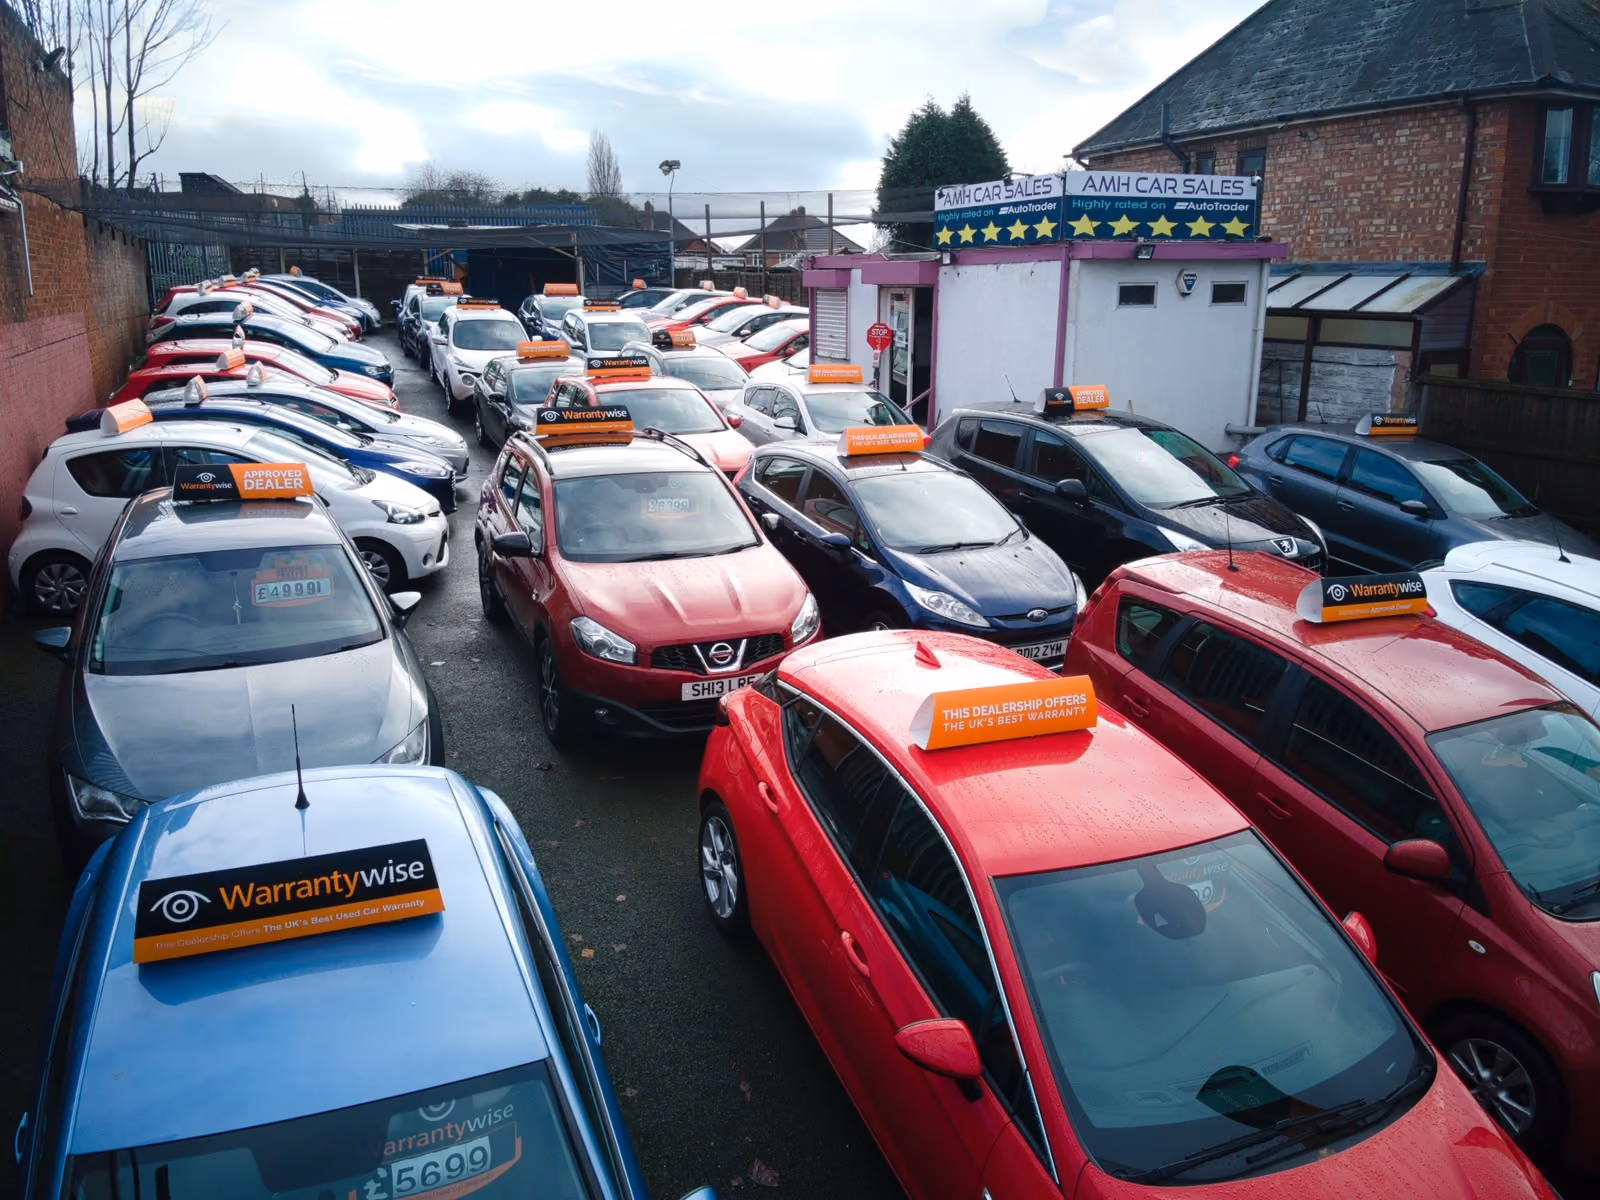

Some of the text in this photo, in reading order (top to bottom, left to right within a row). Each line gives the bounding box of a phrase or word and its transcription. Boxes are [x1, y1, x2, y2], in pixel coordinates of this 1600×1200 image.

[944, 178, 1052, 207] AMH CAR SALES
[1082, 175, 1244, 196] AMH CAR SALES
[938, 202, 1057, 222] Highly rated on AutoTrader
[1072, 199, 1249, 212] Highly rated on AutoTrader
[871, 328, 888, 336] STOP
[603, 358, 647, 368] Warrantywise
[562, 408, 627, 420] Warrantywise
[243, 469, 302, 479] APPROVED
[180, 481, 233, 491] Warrantywise
[243, 478, 304, 491] DEALER
[1349, 579, 1423, 597] Warrantywise
[691, 680, 725, 697] SH13
[942, 693, 1087, 721] THIS DEALERSHIP OFFERS
[943, 706, 1087, 732] THE UK'S BEST WARRANTY
[218, 859, 425, 911] Warrantywise
[264, 924, 282, 933] The
[285, 919, 308, 929] UK's
[311, 915, 333, 925] Best
[335, 910, 361, 920] Used
[363, 906, 380, 916] Car
[382, 899, 425, 913] Warranty
[384, 1103, 514, 1157] arrantywise
